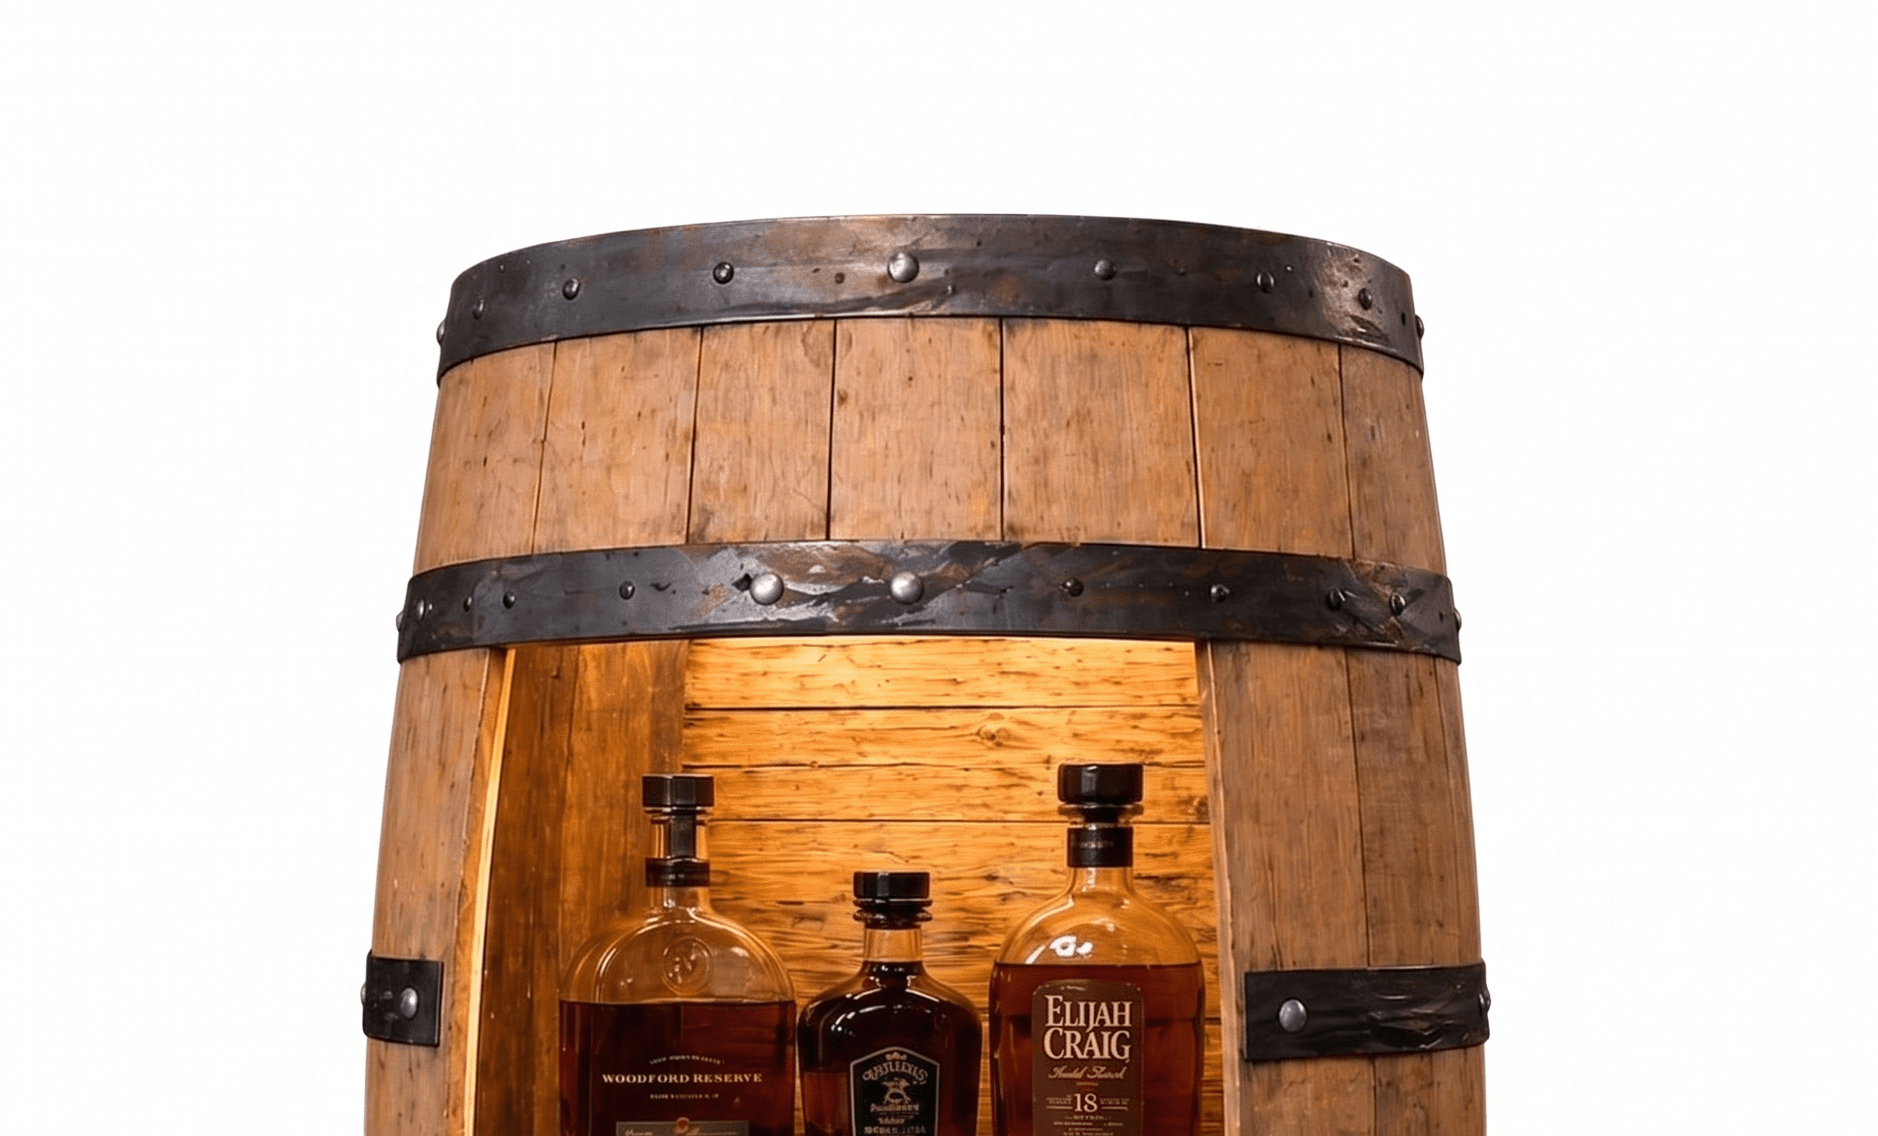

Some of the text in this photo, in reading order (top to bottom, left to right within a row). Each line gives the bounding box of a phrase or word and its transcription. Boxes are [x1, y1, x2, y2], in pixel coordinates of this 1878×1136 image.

[1044, 995, 1133, 1033] ELIJAH
[1043, 1027, 1132, 1063] CRAIG
[602, 1073, 763, 1083] WOODFORD RESERVE
[1074, 1093, 1098, 1112] 18
